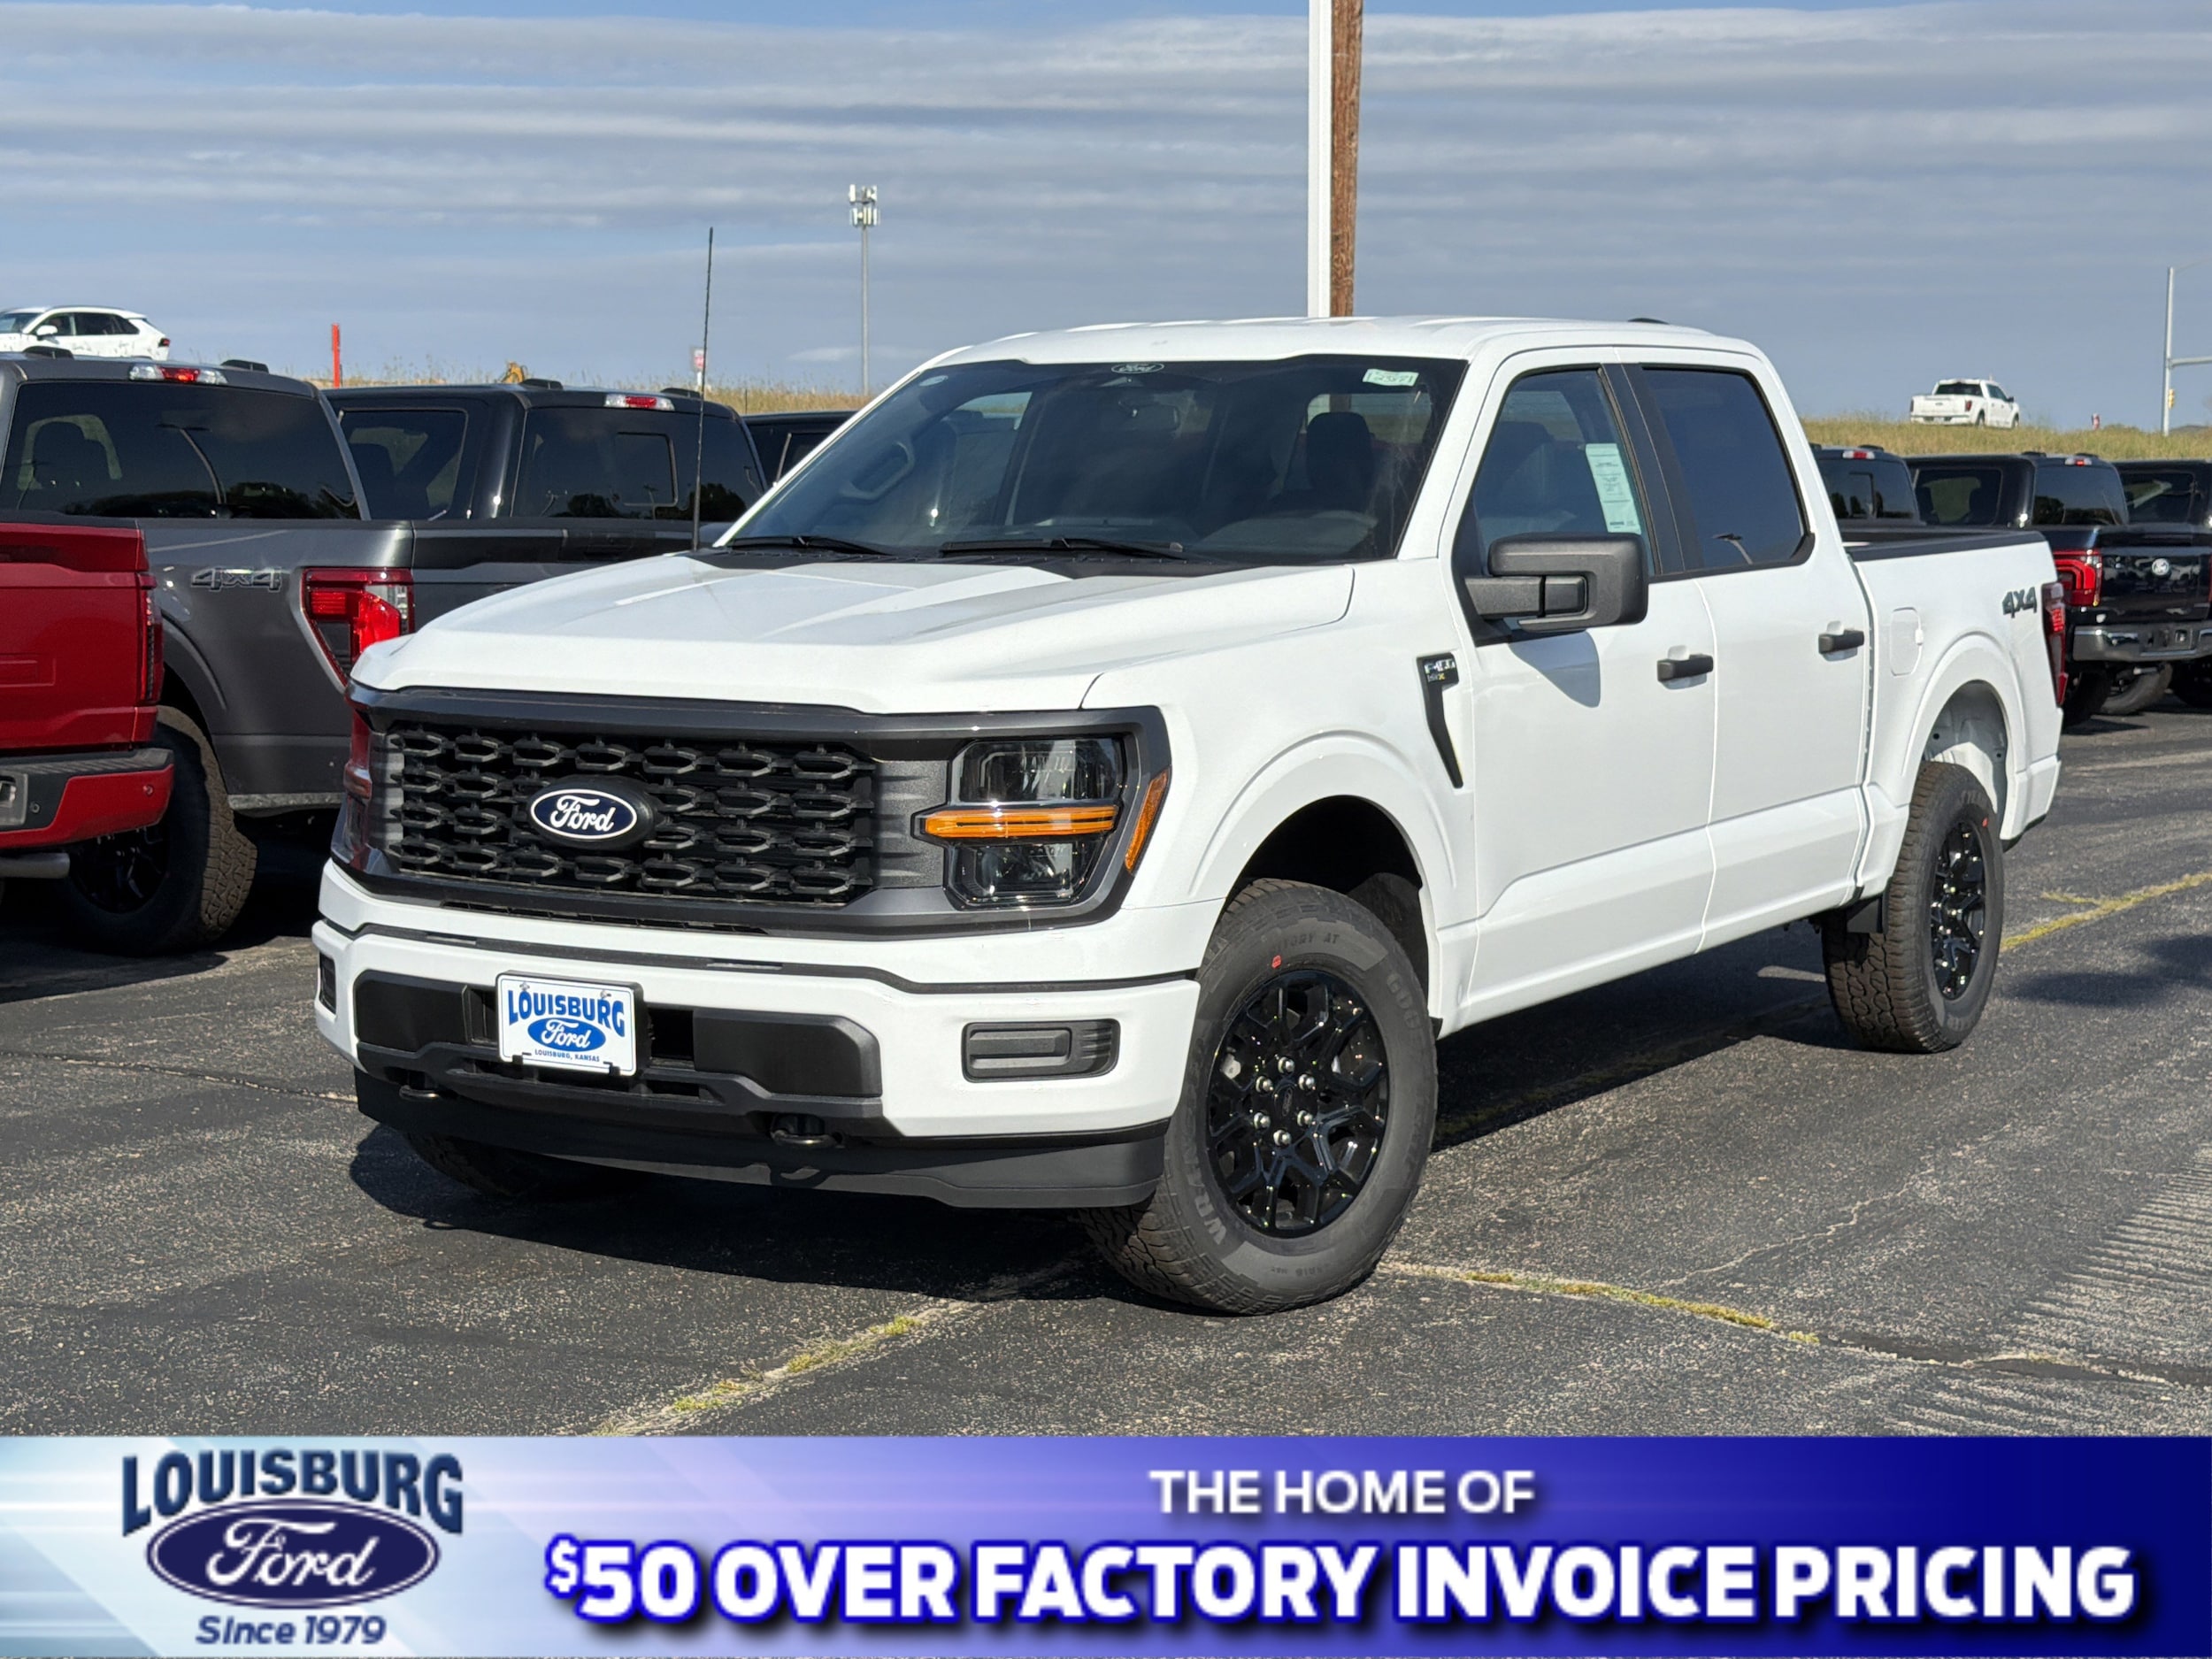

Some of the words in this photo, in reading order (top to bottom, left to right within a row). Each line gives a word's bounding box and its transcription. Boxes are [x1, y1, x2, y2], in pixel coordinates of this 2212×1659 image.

[549, 795, 617, 832] Ford
[508, 989, 626, 1038] LOUISBURG
[541, 1018, 592, 1049] Ford
[534, 1048, 573, 1060] LOUISBURG,
